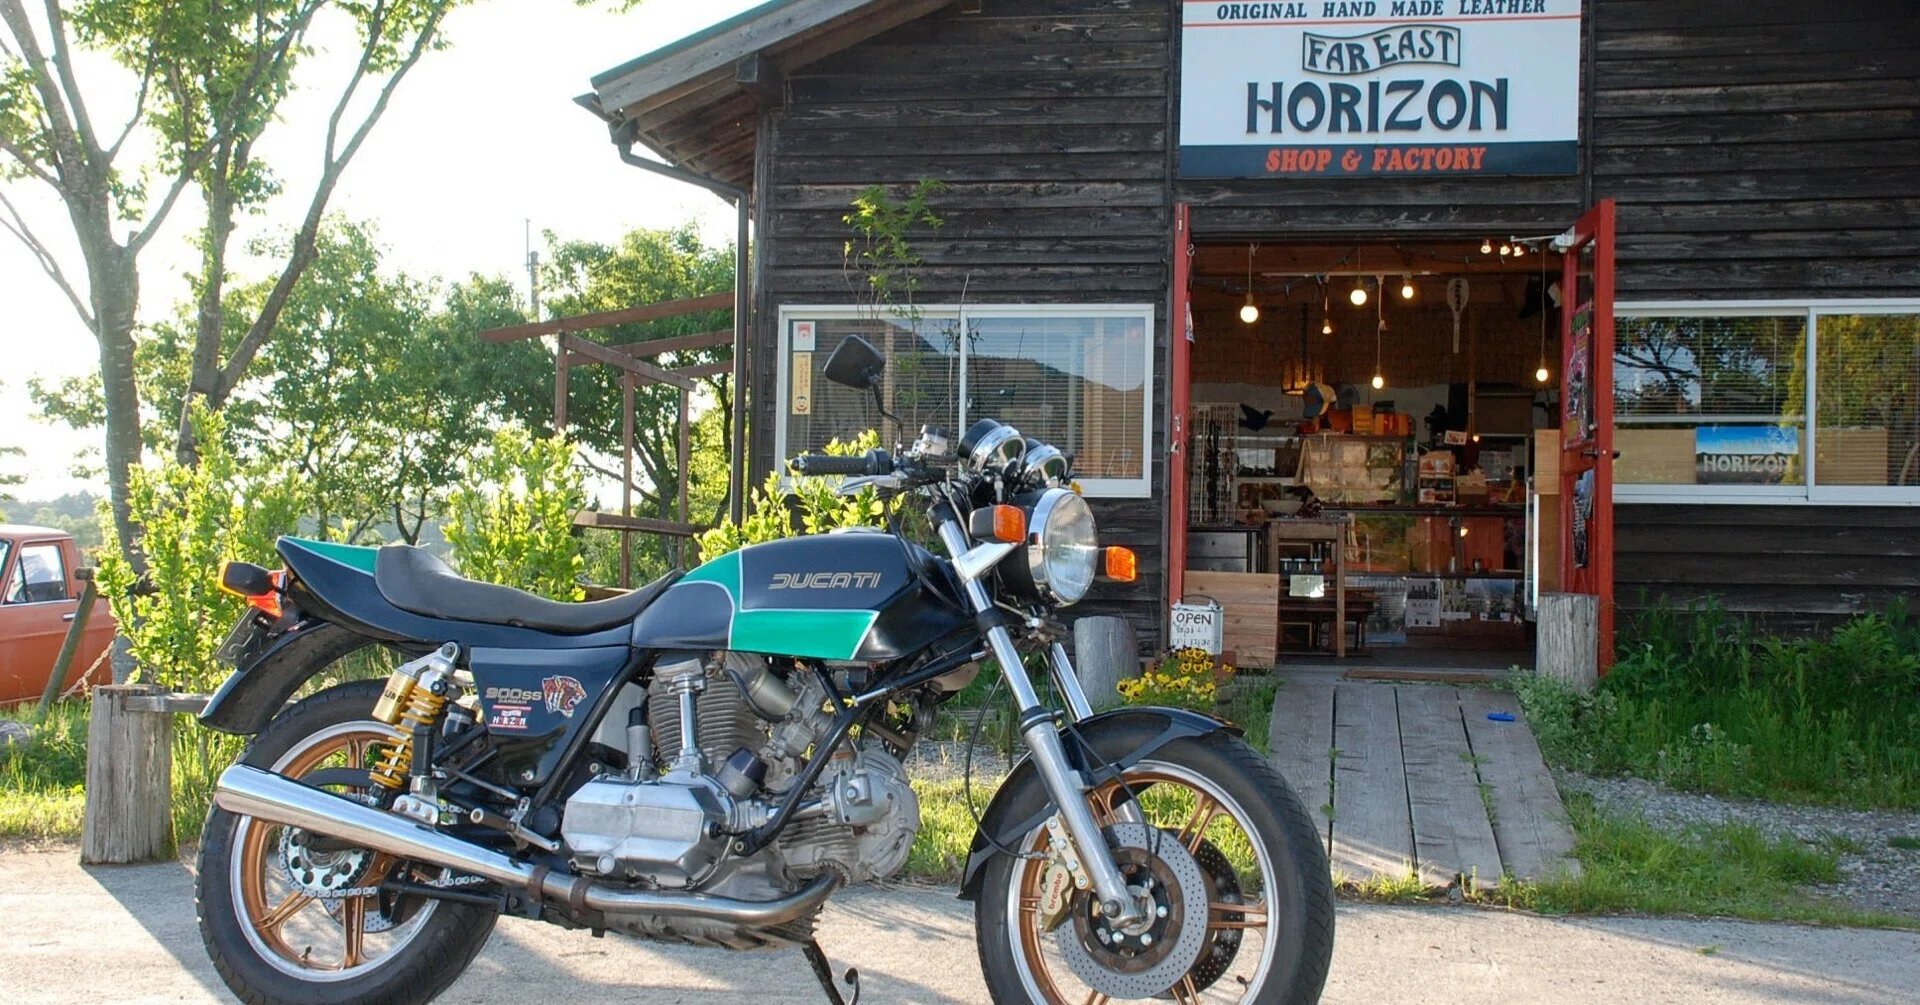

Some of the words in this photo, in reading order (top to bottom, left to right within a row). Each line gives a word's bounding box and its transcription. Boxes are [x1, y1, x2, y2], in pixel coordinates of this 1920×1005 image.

[1217, 3, 1307, 20] ORIGINAL
[1322, 1, 1376, 18] HAND
[1390, 0, 1444, 16] MADE
[1459, 0, 1545, 15] LEATHER
[1308, 37, 1370, 72] FAR
[1373, 29, 1454, 65] EAST
[1246, 78, 1508, 134] HORIZON
[1265, 149, 1332, 172] SHOP
[1341, 150, 1363, 172] &
[1372, 147, 1487, 171] FACTORY
[1703, 454, 1789, 473] HORIZON
[768, 572, 882, 590] DUCATI
[1048, 872, 1063, 910] brembo
